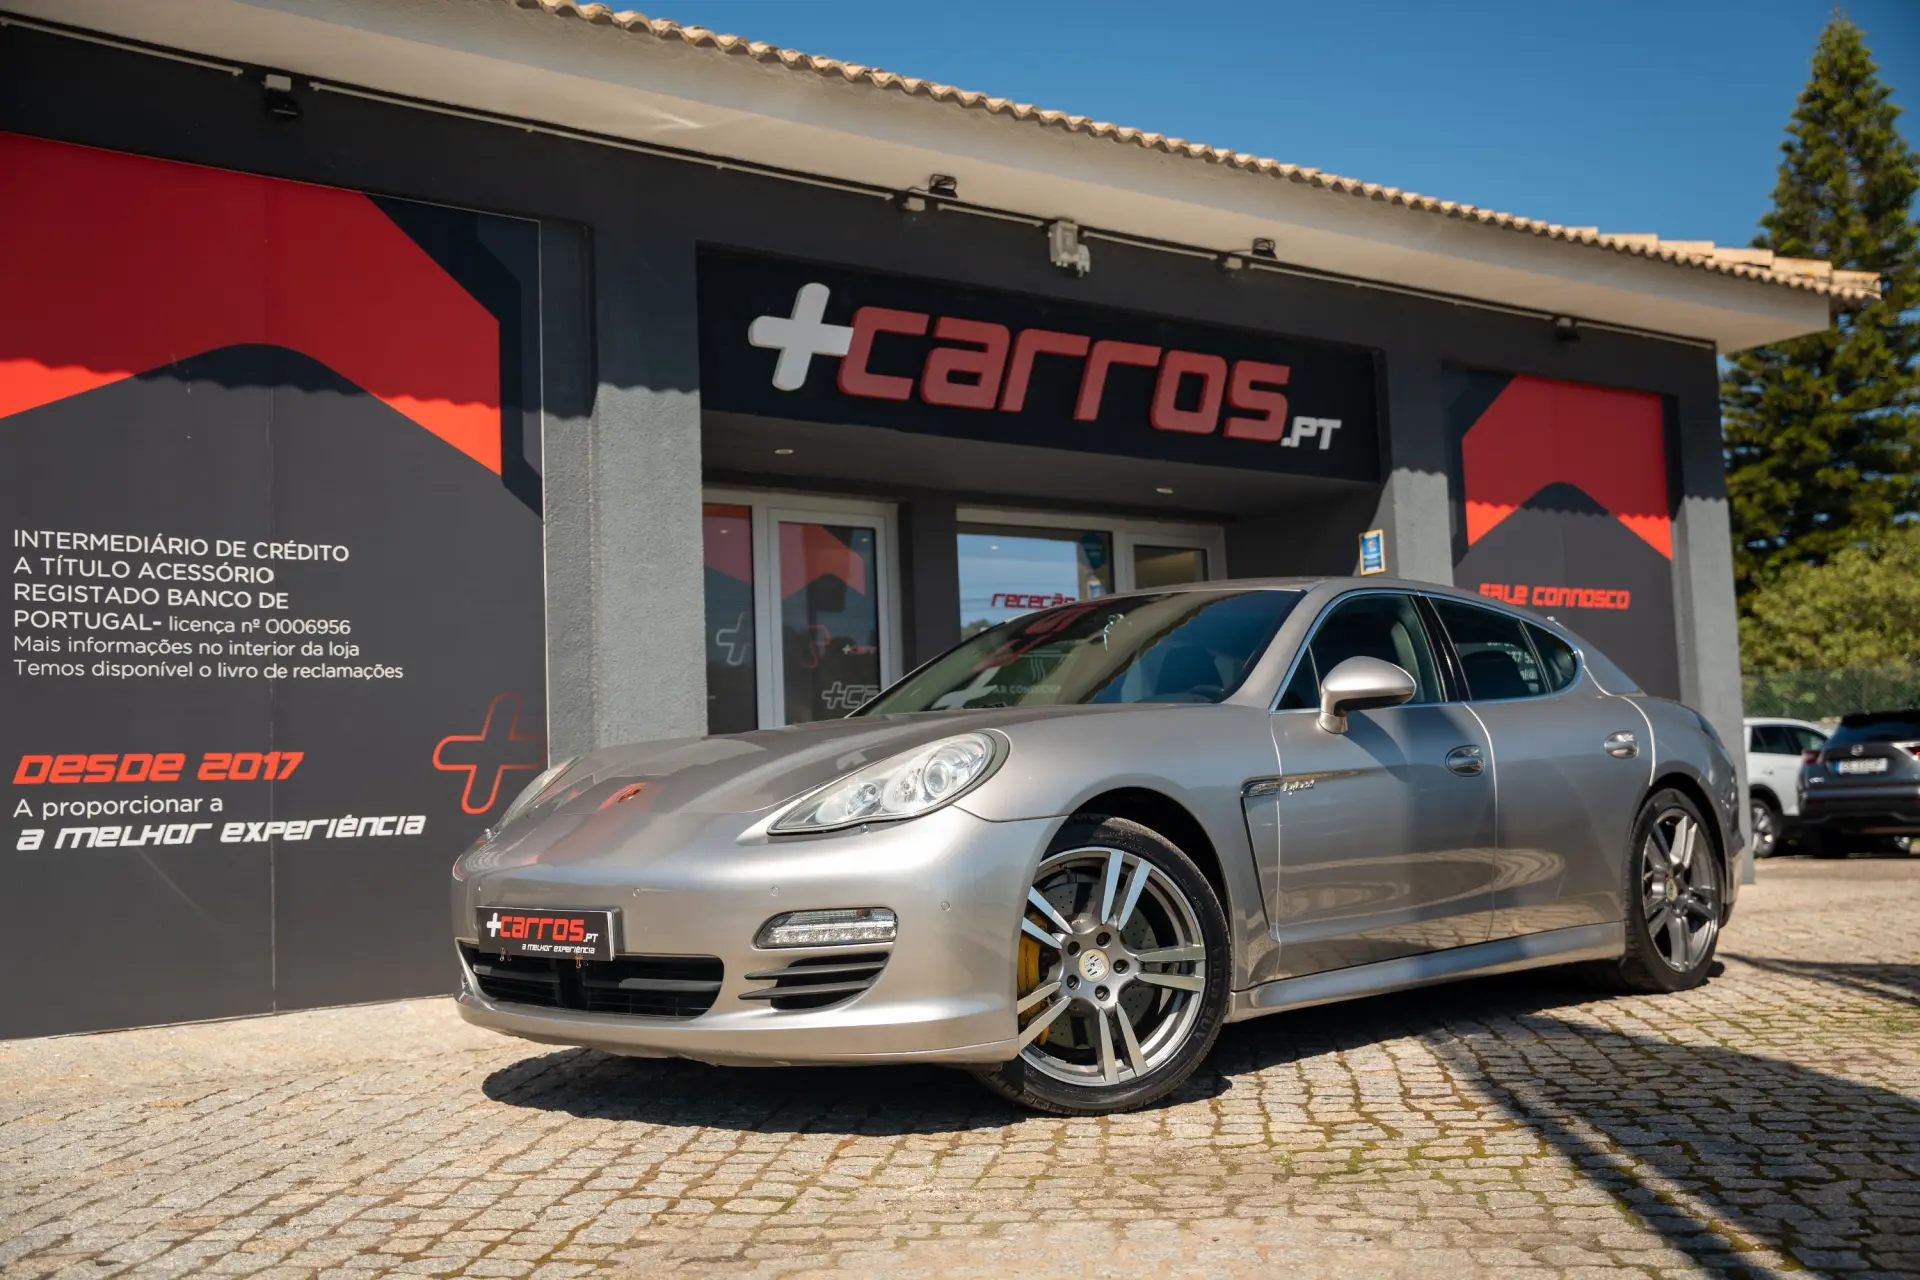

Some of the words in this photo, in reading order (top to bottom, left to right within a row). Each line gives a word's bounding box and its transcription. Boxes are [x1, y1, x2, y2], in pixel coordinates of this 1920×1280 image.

[14, 529, 209, 557] INTERMEDIÁRIO
[215, 539, 247, 558] DE
[252, 539, 350, 562] CRÉDITO
[13, 556, 33, 575] A
[40, 554, 131, 579] TÍTULO
[137, 561, 275, 585] ACESSÓRIO
[14, 582, 160, 606] REGISTADO
[167, 588, 253, 609] BANCO
[258, 591, 290, 610] DE
[14, 609, 162, 631] PORTUGAL-
[169, 615, 236, 635] licença
[265, 618, 352, 635] 0006956
[14, 635, 61, 653] Mais
[68, 636, 193, 657] informações
[198, 642, 224, 656] no
[229, 639, 296, 657] interior
[300, 640, 324, 657] da
[328, 640, 360, 660] loja
[13, 659, 85, 677] Temos
[91, 659, 193, 680] disponível
[198, 665, 212, 678] o
[217, 661, 259, 679] livro
[262, 662, 289, 679] de
[292, 662, 404, 681] reclamações
[196, 750, 305, 781] 2017
[12, 798, 34, 818] A
[42, 794, 204, 821] proporcionar
[209, 797, 223, 813] a
[15, 828, 46, 851] a
